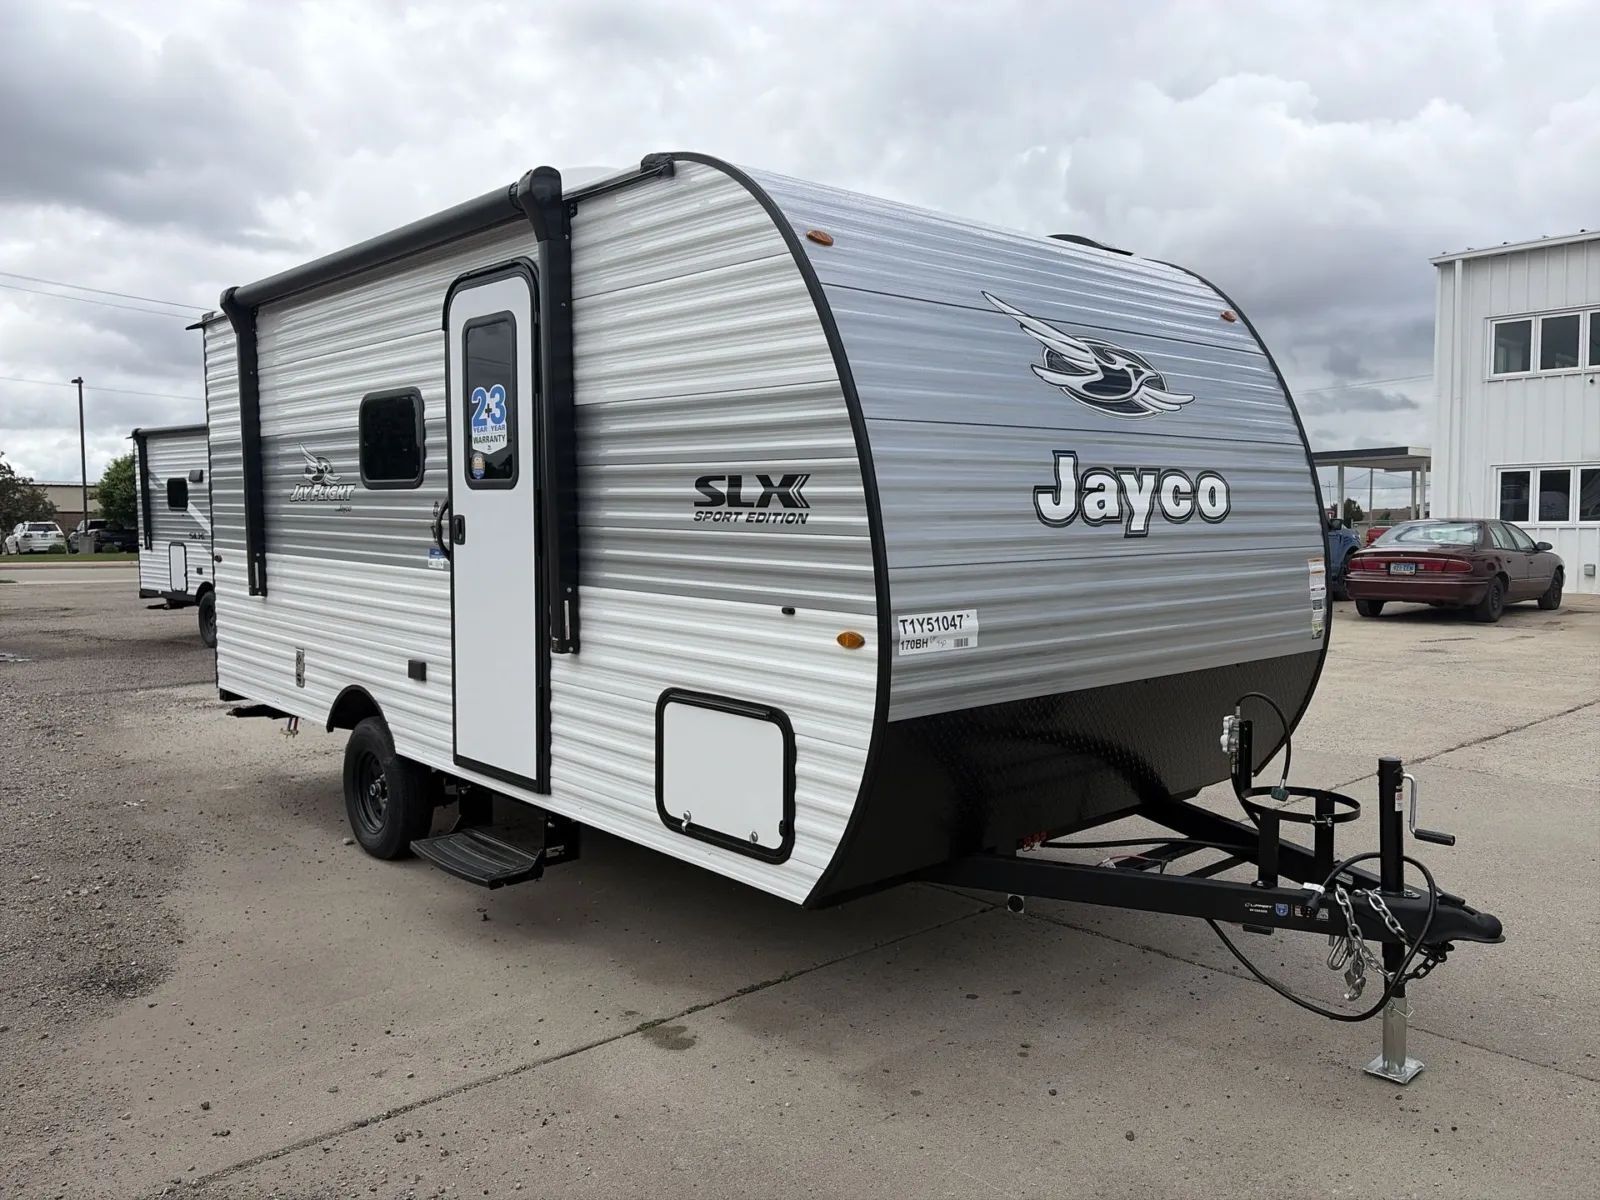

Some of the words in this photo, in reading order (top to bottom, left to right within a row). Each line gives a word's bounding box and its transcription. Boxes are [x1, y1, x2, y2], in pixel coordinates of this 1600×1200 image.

[473, 434, 506, 444] WARRANTY
[289, 484, 312, 502] JAY
[311, 484, 356, 501] FLIGHT
[694, 474, 811, 508] SLX
[1033, 450, 1231, 538] Jayco
[694, 511, 742, 522] SPORT
[745, 512, 809, 524] EDITION
[899, 614, 963, 634] T1Y51047
[900, 638, 928, 650] 170BH
